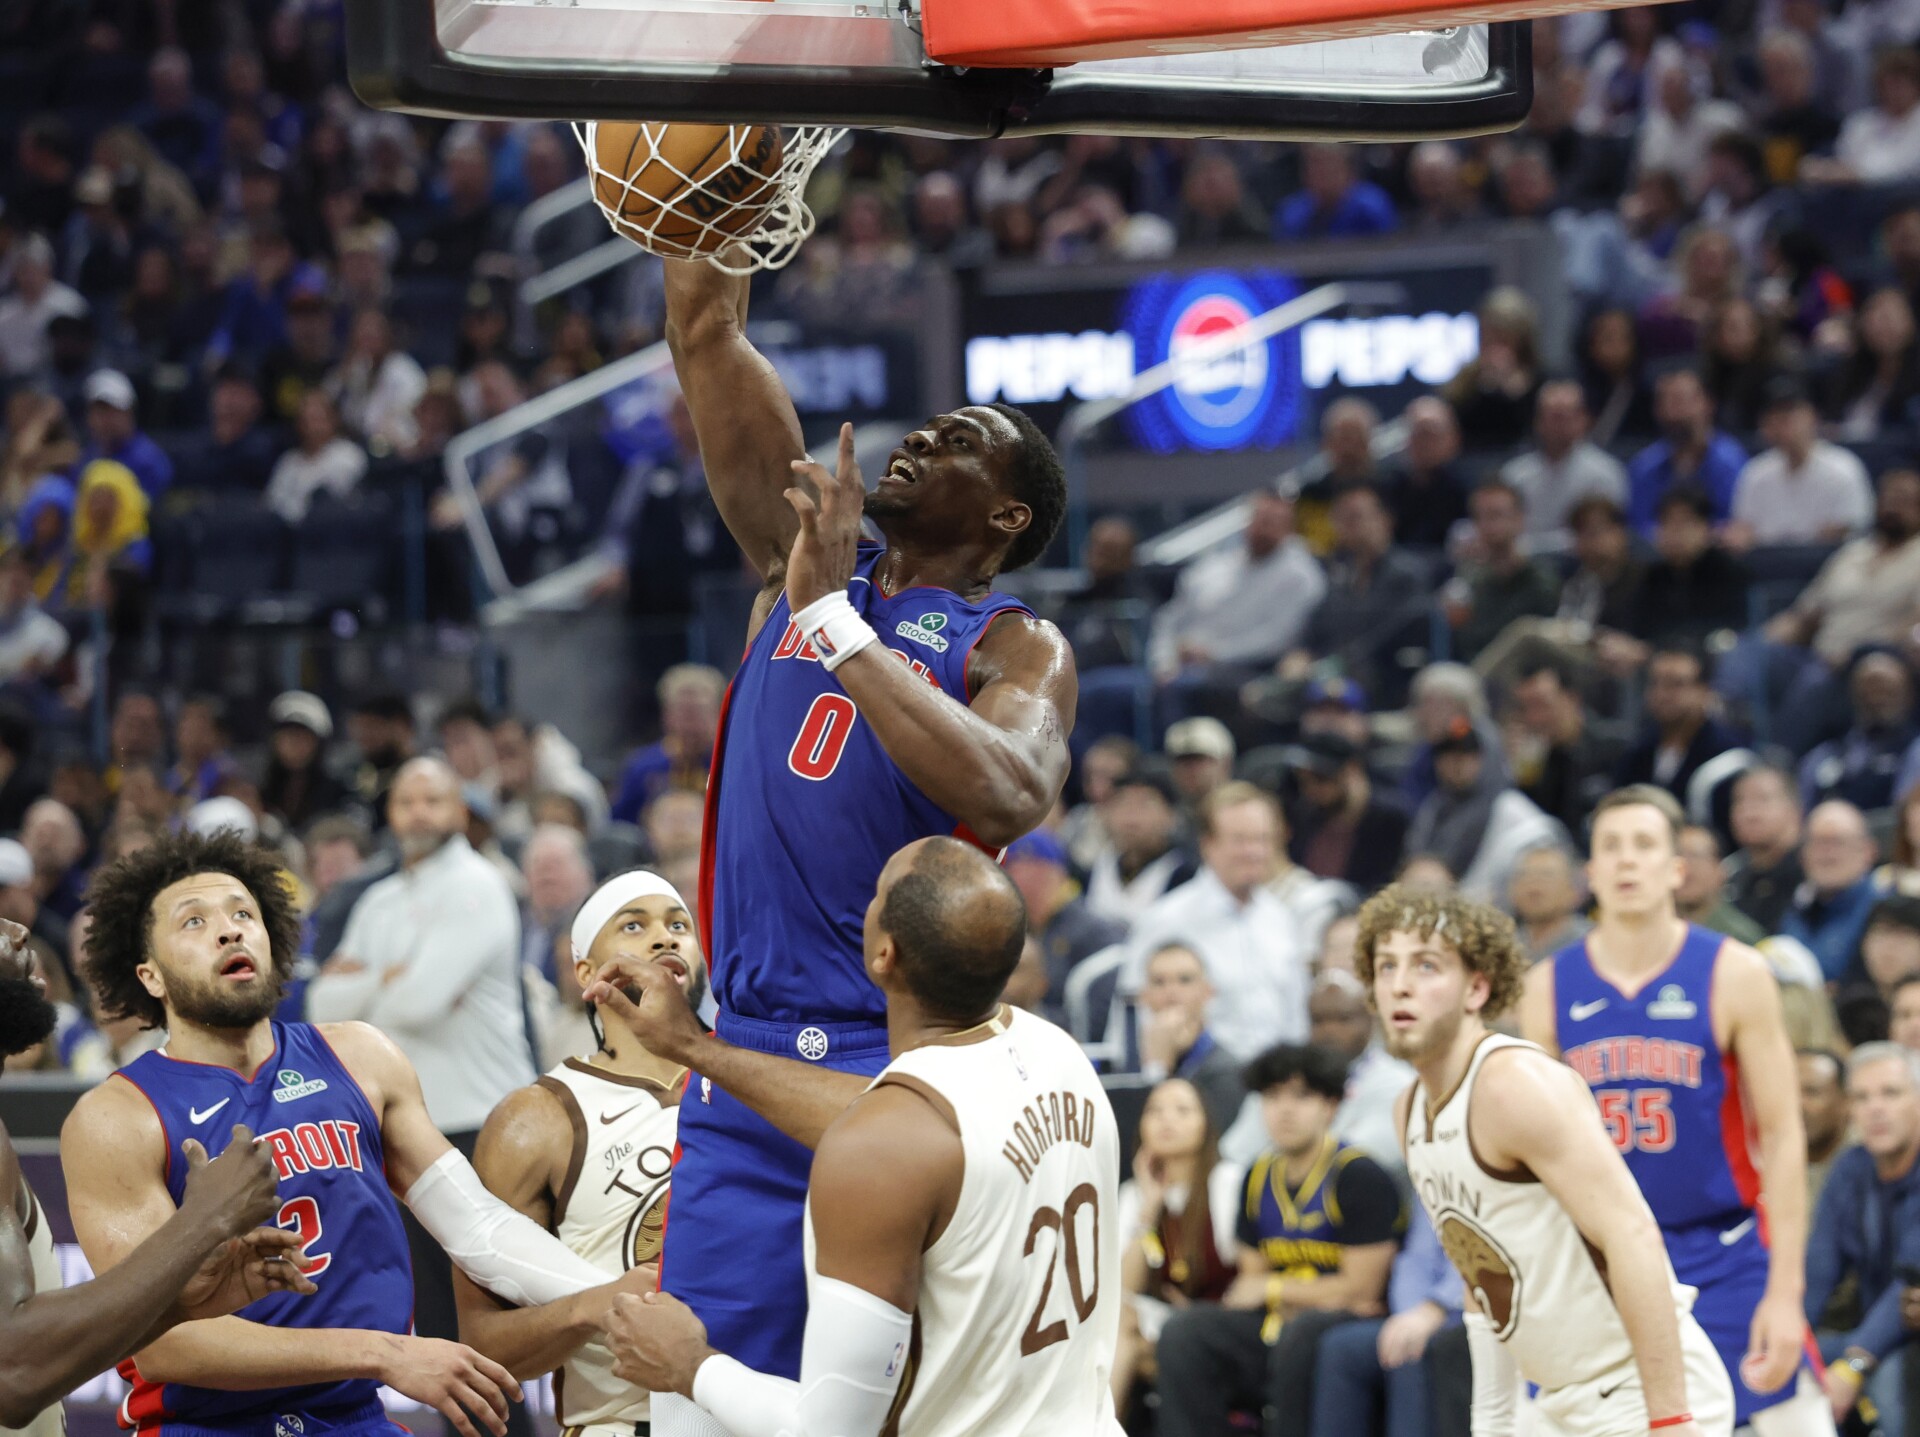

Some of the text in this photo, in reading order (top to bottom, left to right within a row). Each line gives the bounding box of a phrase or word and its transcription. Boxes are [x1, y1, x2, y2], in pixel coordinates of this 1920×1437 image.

[966, 329, 1135, 403] PEPSI
[1301, 311, 1481, 388] PEPSI
[788, 693, 857, 781] 0
[250, 1120, 363, 1181] ROIT
[604, 1141, 633, 1171] The
[1002, 1091, 1095, 1185] HORFORD
[1597, 1088, 1677, 1155] 55
[604, 1145, 672, 1198] TO
[1412, 1170, 1481, 1218] OWN
[277, 1196, 331, 1278] 2
[1021, 1183, 1099, 1357] 20
